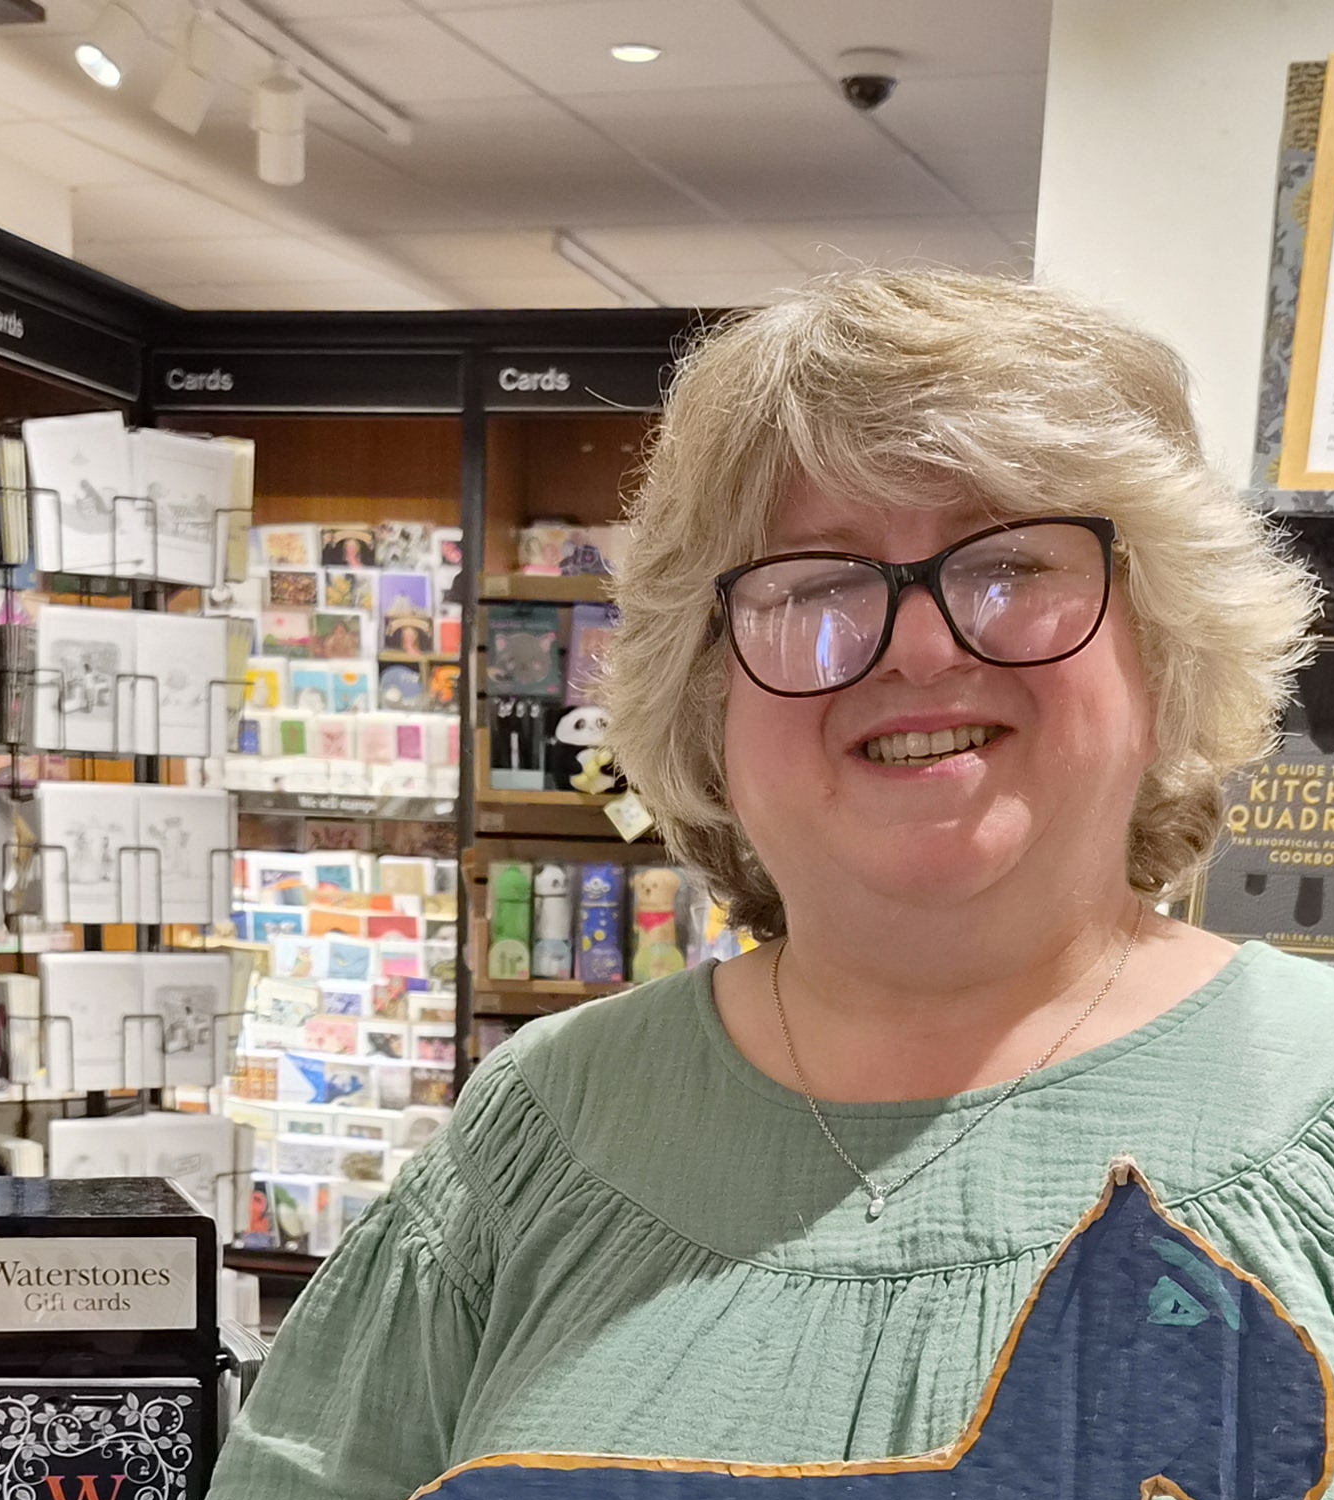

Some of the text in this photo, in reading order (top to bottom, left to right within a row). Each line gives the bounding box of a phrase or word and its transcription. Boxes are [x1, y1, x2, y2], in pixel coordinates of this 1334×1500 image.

[167, 367, 234, 392] Cards
[498, 367, 571, 392] Cards
[1261, 765, 1269, 775] A
[1277, 764, 1325, 777] GUIDE
[1255, 838, 1319, 849] UNOFFICIAL
[24, 1292, 131, 1311] Gift cards
